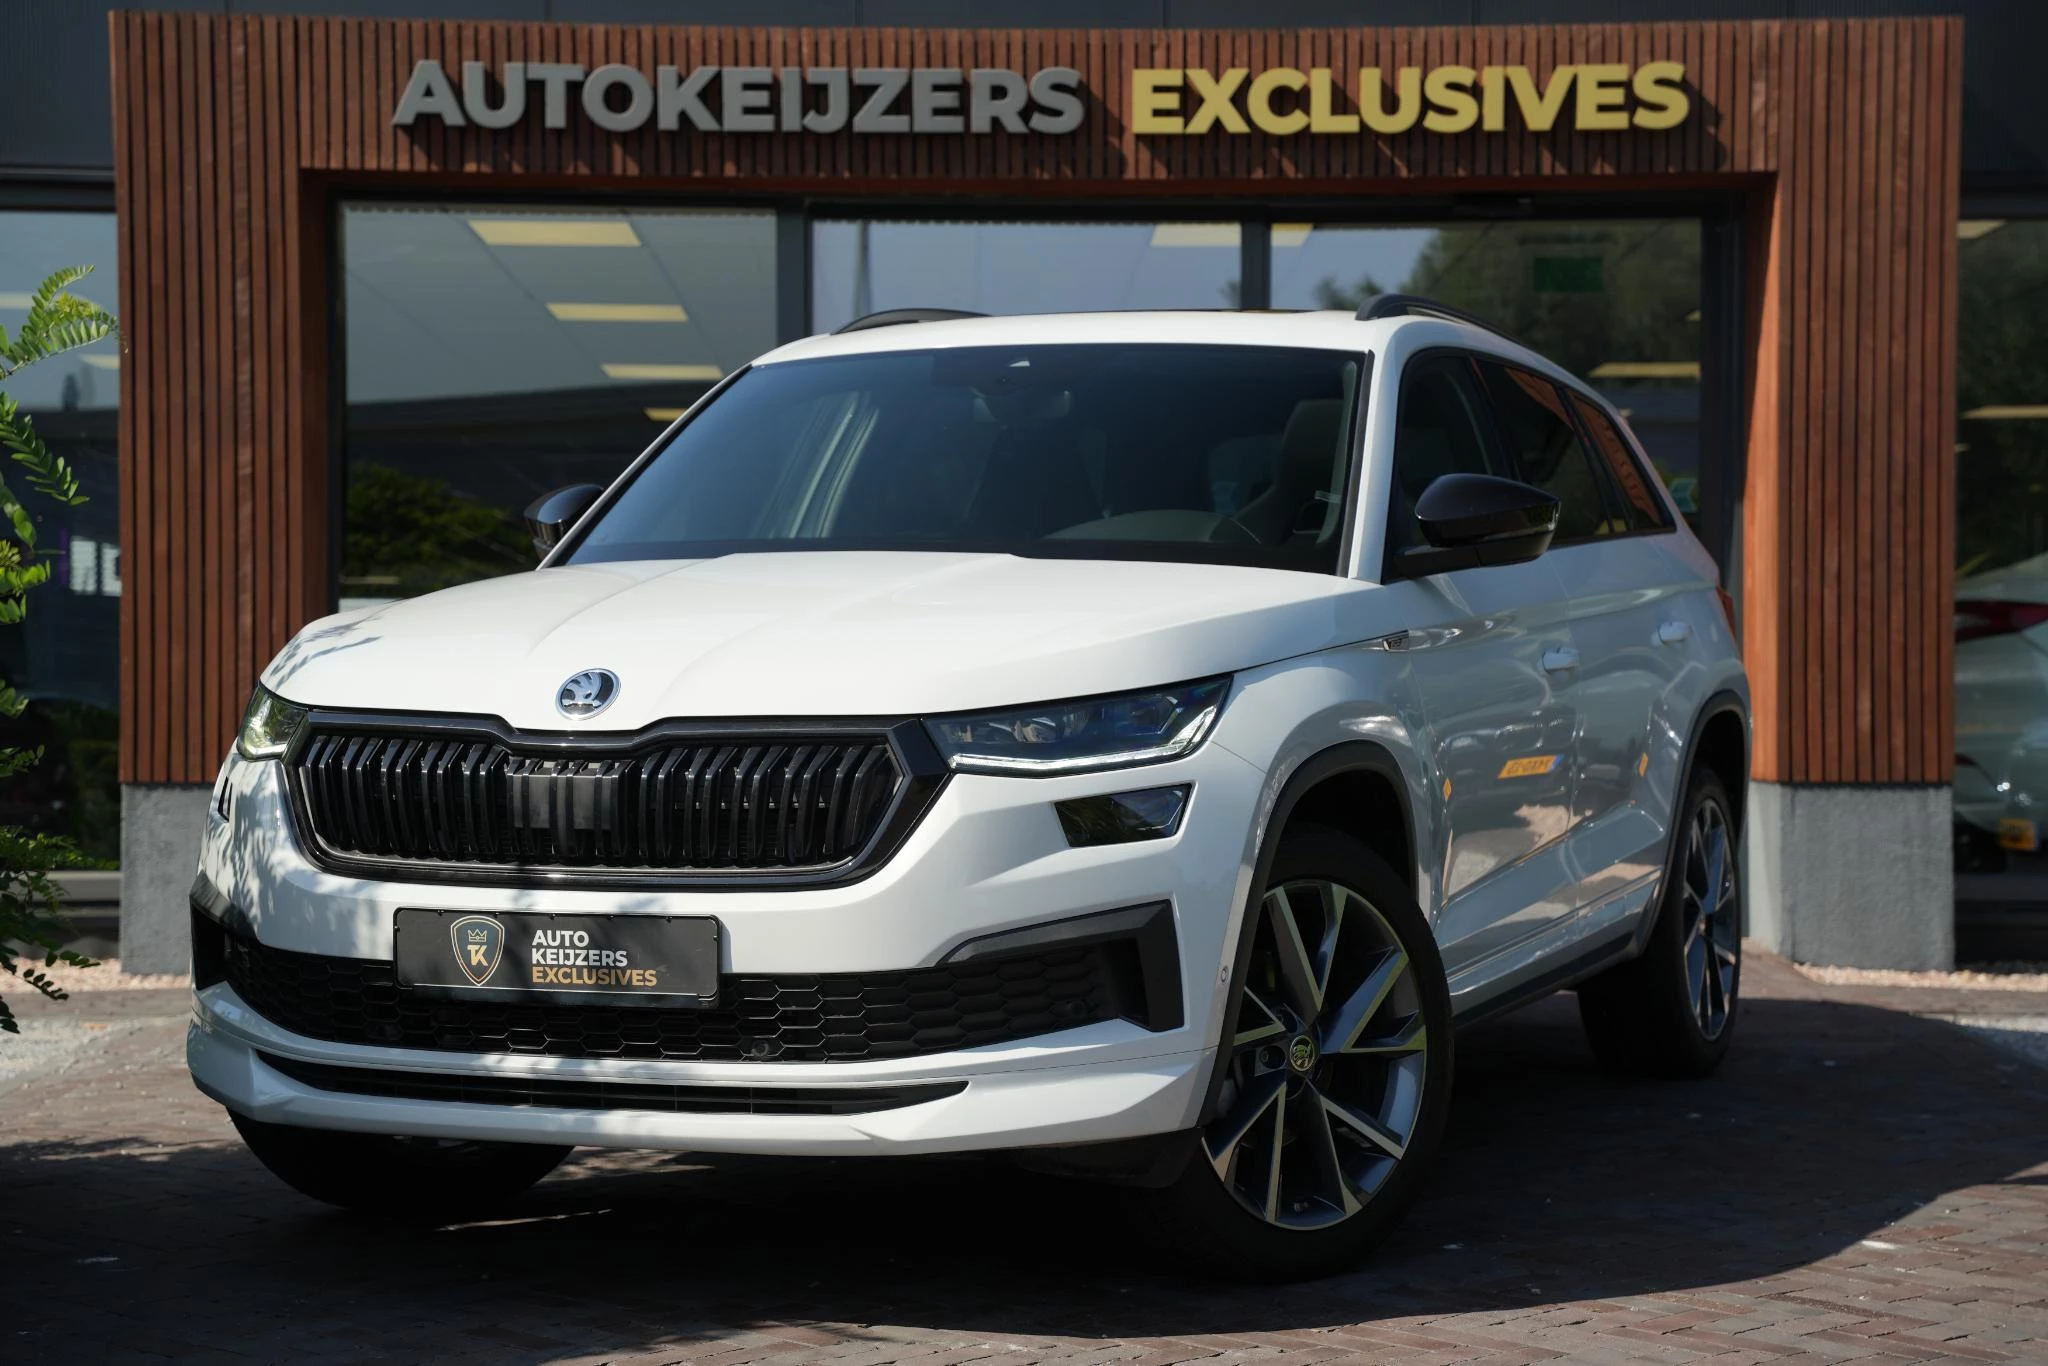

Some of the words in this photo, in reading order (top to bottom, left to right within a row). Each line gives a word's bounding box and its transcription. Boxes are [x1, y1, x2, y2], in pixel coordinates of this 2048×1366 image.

[393, 60, 1085, 134] AUTOKEIJZERS
[1132, 61, 1690, 135] EXCLUSIVES
[531, 929, 590, 947] AUTO
[531, 947, 628, 967] KEIJZERS
[531, 966, 658, 986] EXCLUSIVES
